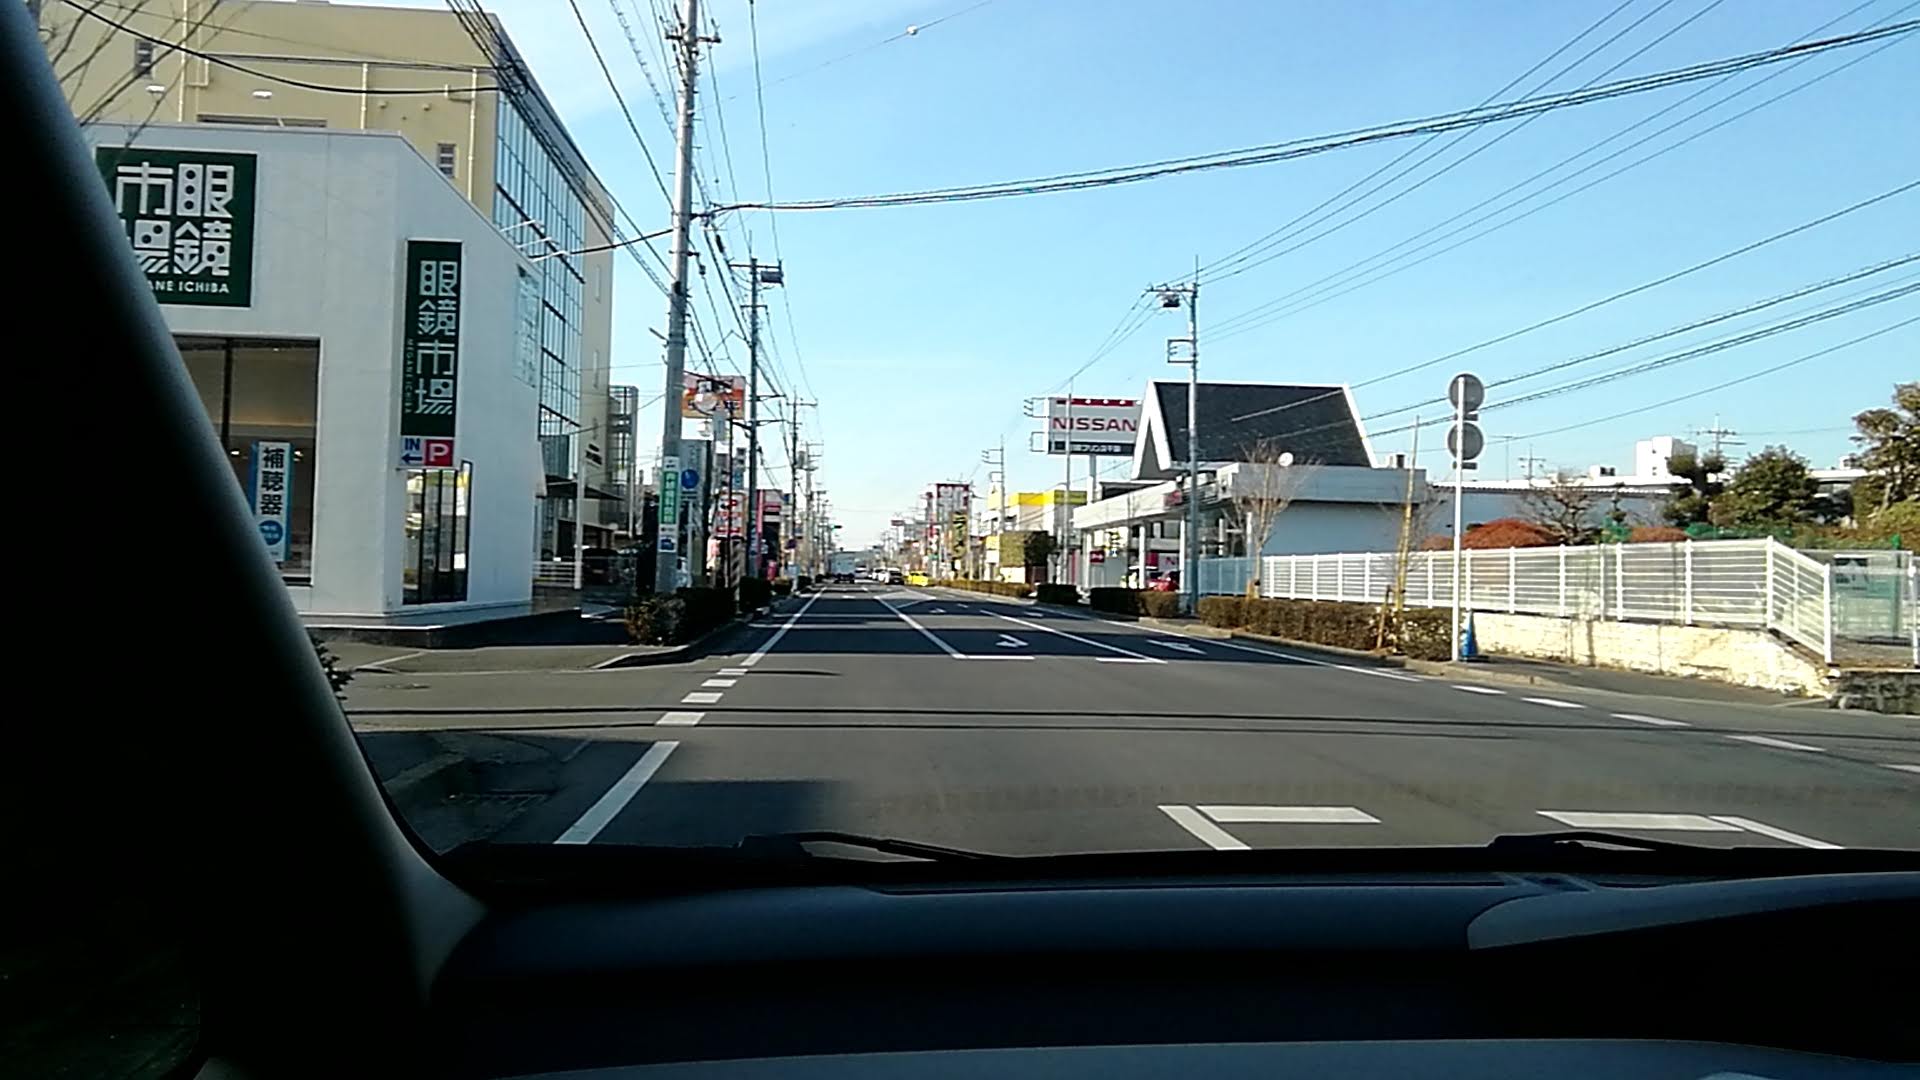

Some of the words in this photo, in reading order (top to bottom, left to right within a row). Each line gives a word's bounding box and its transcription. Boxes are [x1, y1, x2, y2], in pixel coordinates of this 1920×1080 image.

[178, 281, 230, 294] ICHIBA
[415, 260, 459, 415] 眼鏡市場
[1052, 416, 1138, 432] NISSAN
[404, 438, 420, 451] IN
[428, 443, 449, 462] P
[260, 447, 285, 516] 補聴器
